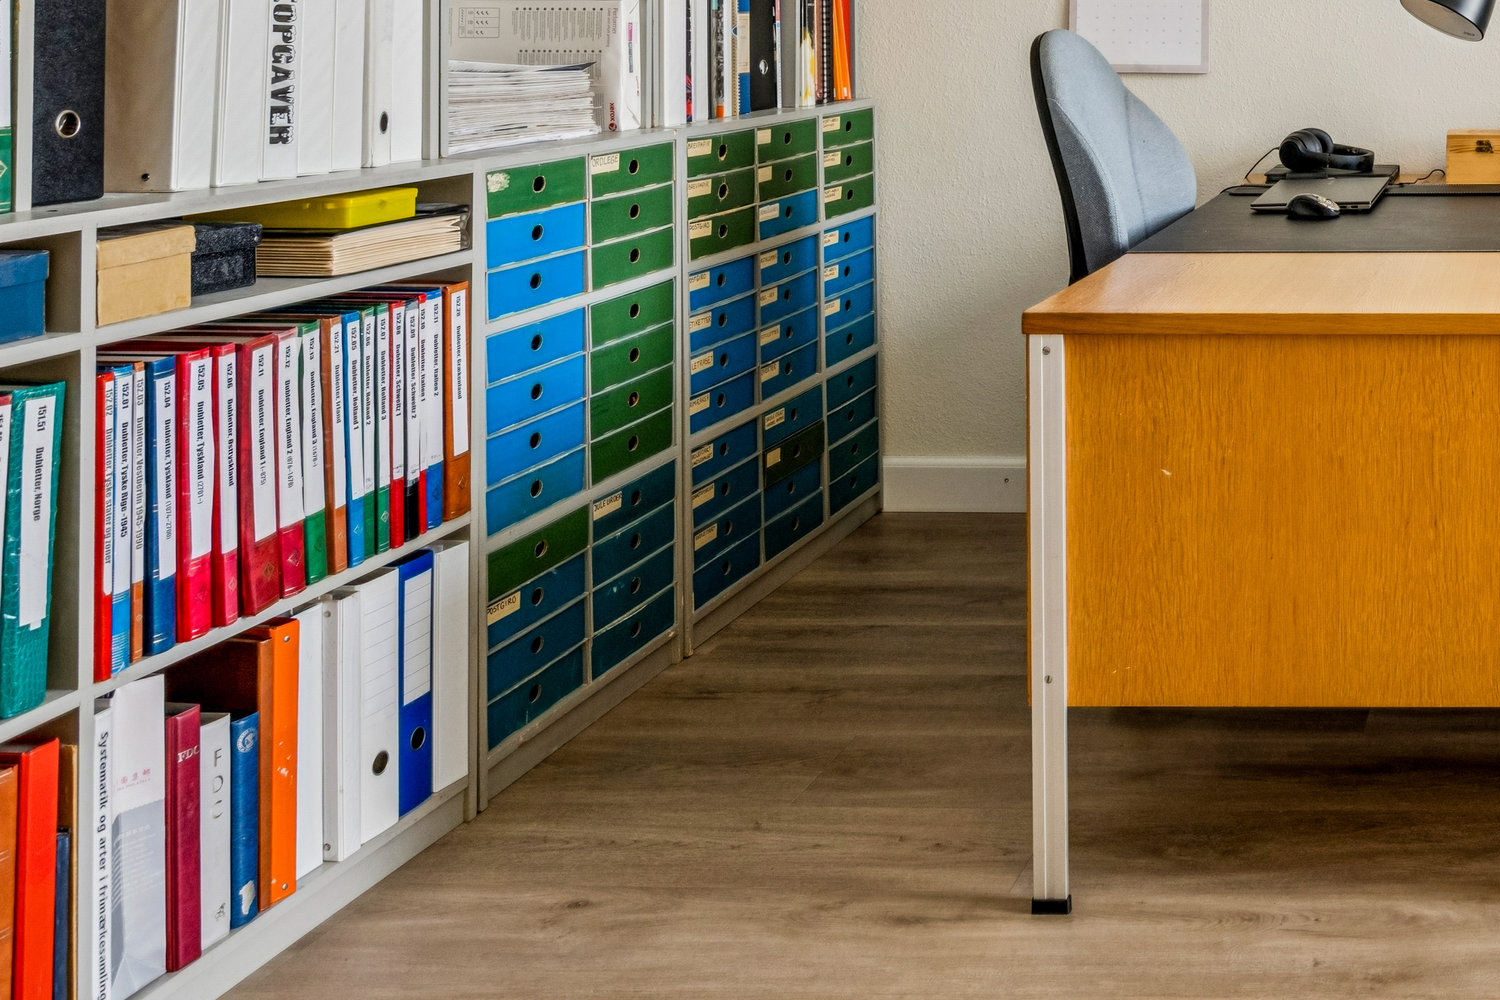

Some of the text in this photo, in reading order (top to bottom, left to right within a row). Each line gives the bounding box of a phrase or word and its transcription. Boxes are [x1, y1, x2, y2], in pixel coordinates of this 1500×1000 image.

[121, 422, 129, 464] Dubletter,
[33, 405, 47, 521] 151.51 Dubletter, Norge
[120, 466, 128, 490] Tyske
[196, 443, 204, 479] Tyskland
[120, 491, 128, 511] Rige
[97, 732, 109, 809] Systematik
[178, 744, 200, 763] FDC
[97, 816, 107, 833] og
[99, 838, 108, 872] arter
